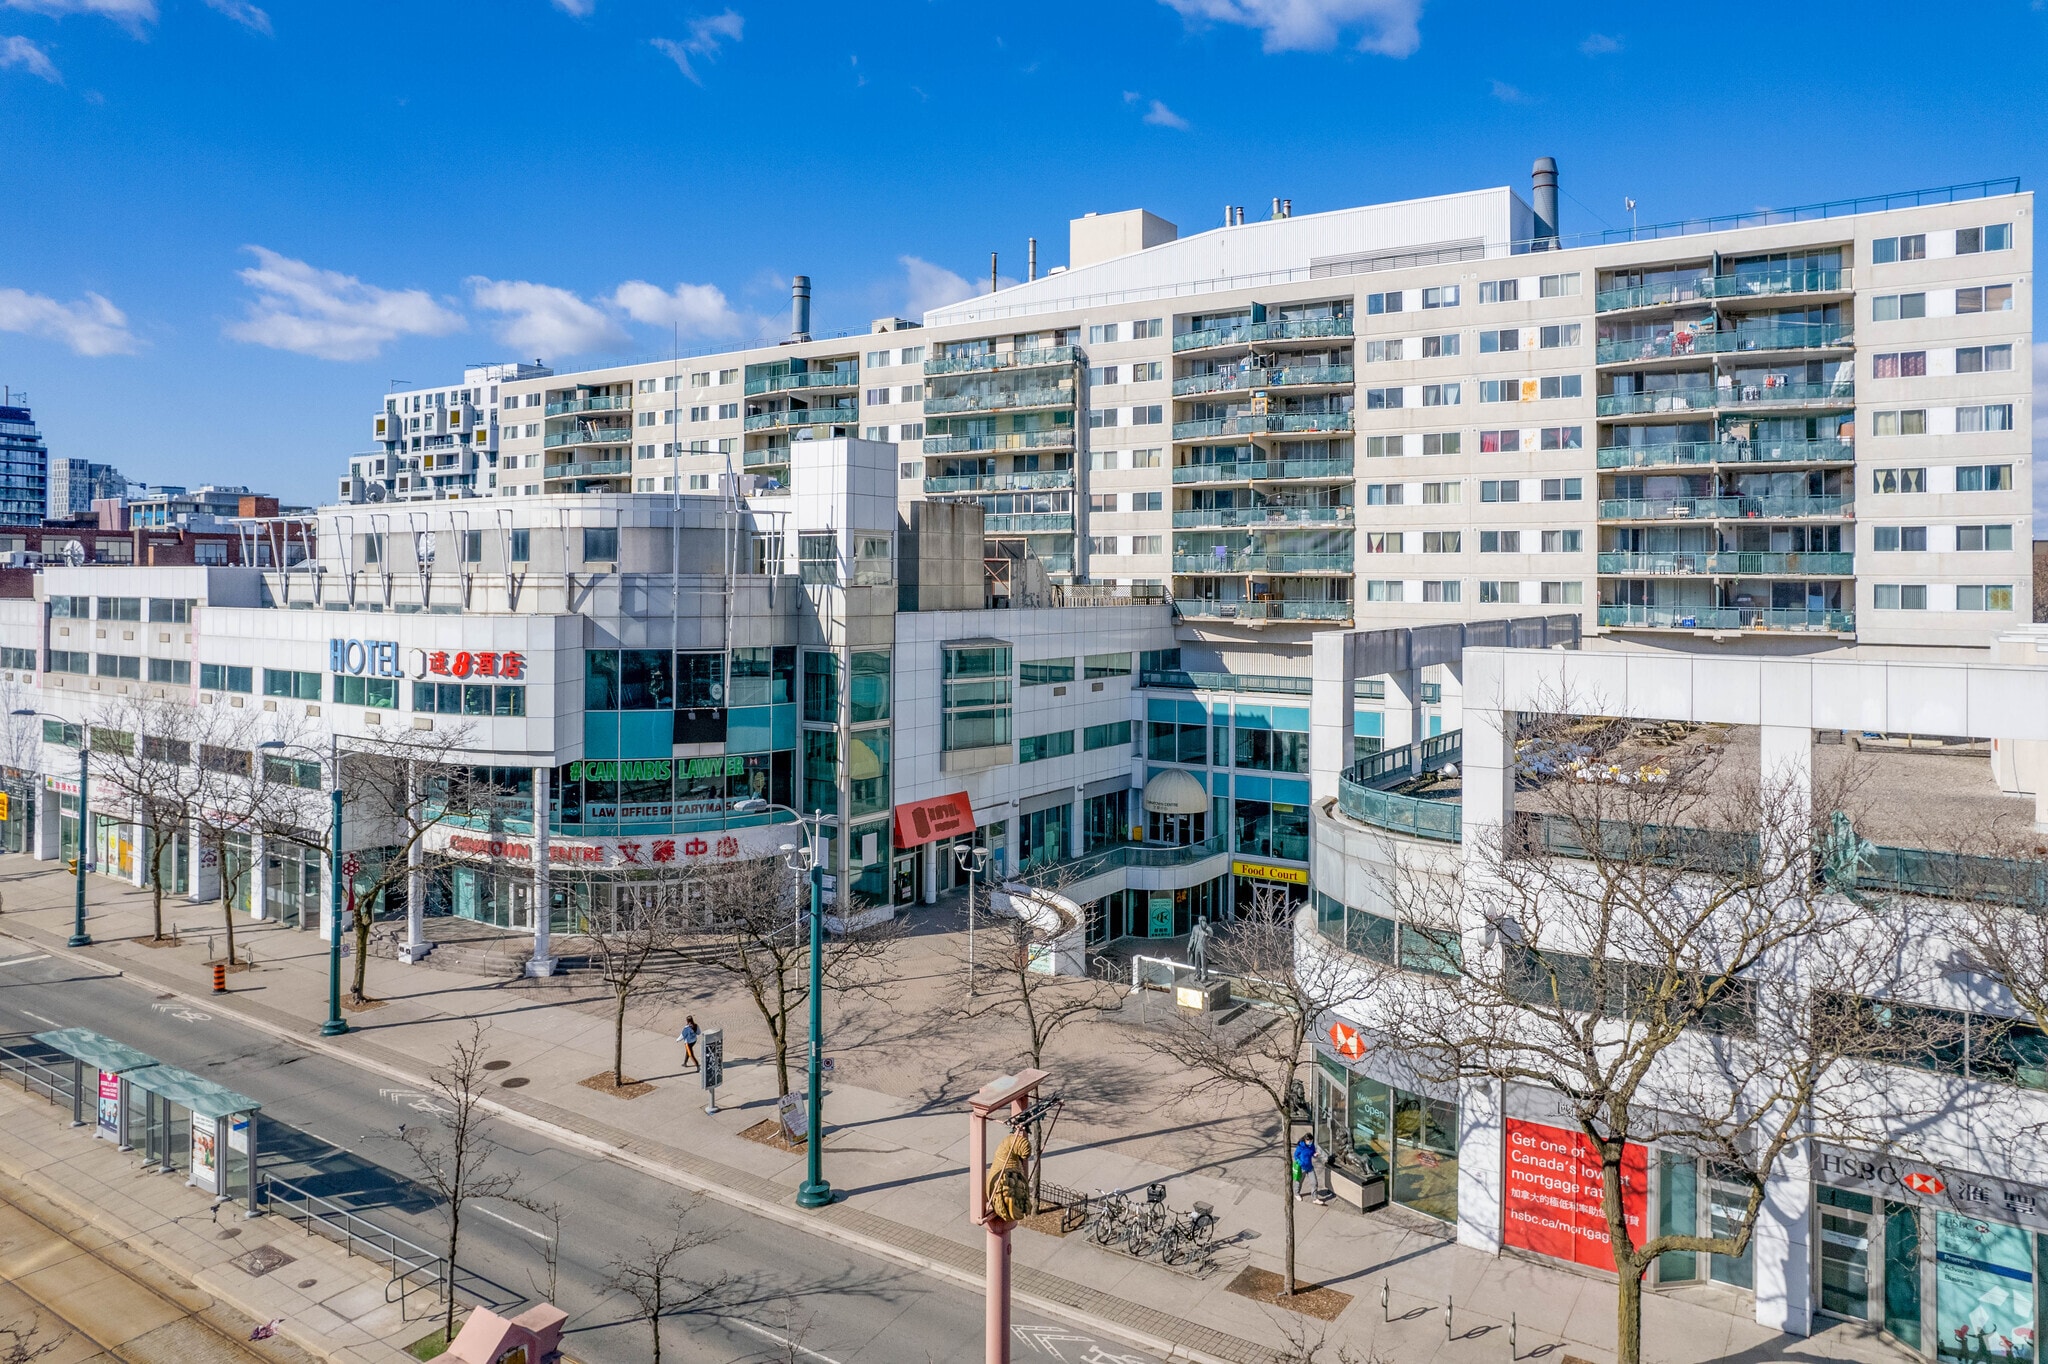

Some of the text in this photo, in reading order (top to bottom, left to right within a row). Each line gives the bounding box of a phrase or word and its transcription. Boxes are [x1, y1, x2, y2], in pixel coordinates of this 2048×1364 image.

[330, 638, 404, 678] HOTEL
[429, 650, 526, 678] 速8酒店
[679, 756, 745, 780] LAWYER
[592, 807, 617, 818] LAW
[621, 806, 657, 818] OFFICE
[676, 801, 722, 816] CARYMA
[548, 845, 604, 862] ENTRE
[1241, 864, 1299, 881] Food Court
[1364, 1103, 1386, 1121] open
[1511, 1132, 1586, 1158] Get one of
[1511, 1150, 1630, 1187] Canada's lowst
[1821, 1153, 1898, 1186] HSBC
[1511, 1169, 1580, 1194] mortgage
[1943, 1253, 1972, 1267] Premier
[1944, 1264, 1975, 1276] Advance
[1944, 1273, 1975, 1288] Business
